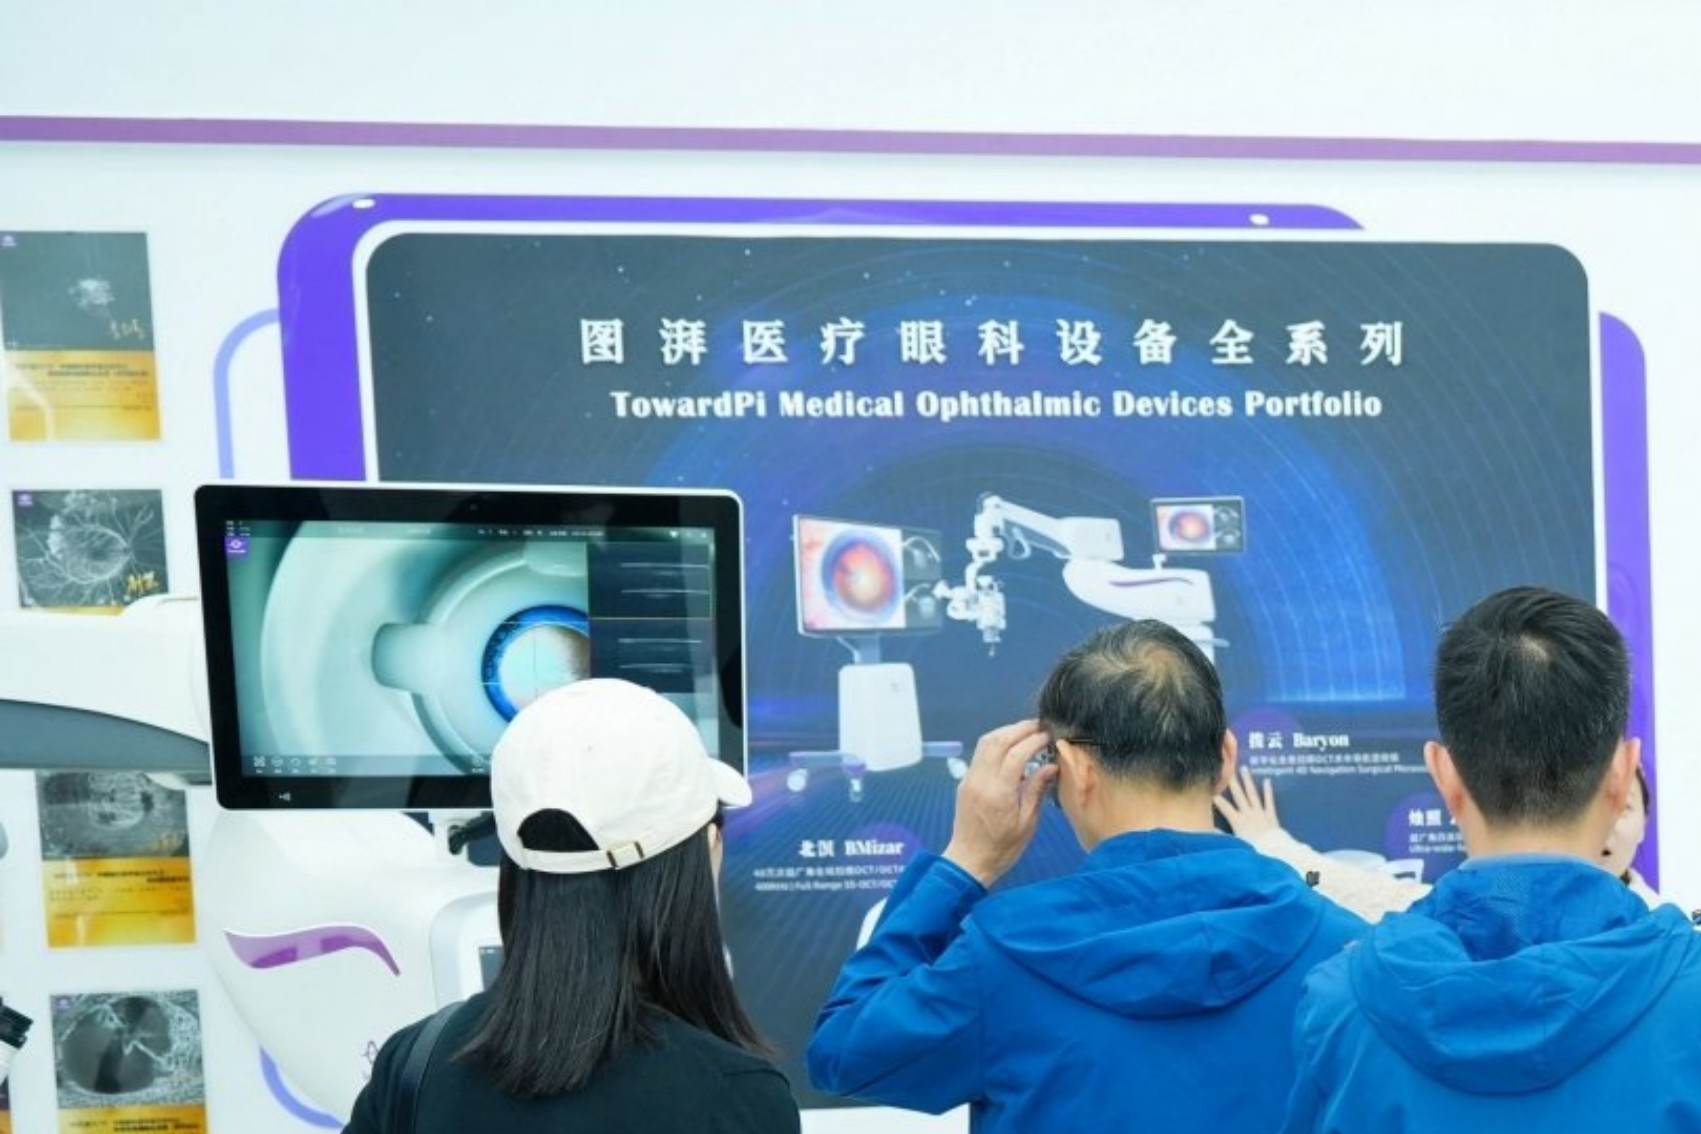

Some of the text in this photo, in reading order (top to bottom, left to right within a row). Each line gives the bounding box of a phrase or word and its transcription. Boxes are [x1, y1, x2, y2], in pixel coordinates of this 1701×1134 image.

[580, 317, 1403, 365] 图湃医疗眼科设备全系列
[610, 389, 1383, 422] TowardPi Medical Ophthalmic Devices Portfolio
[1292, 733, 1350, 752] Baryon
